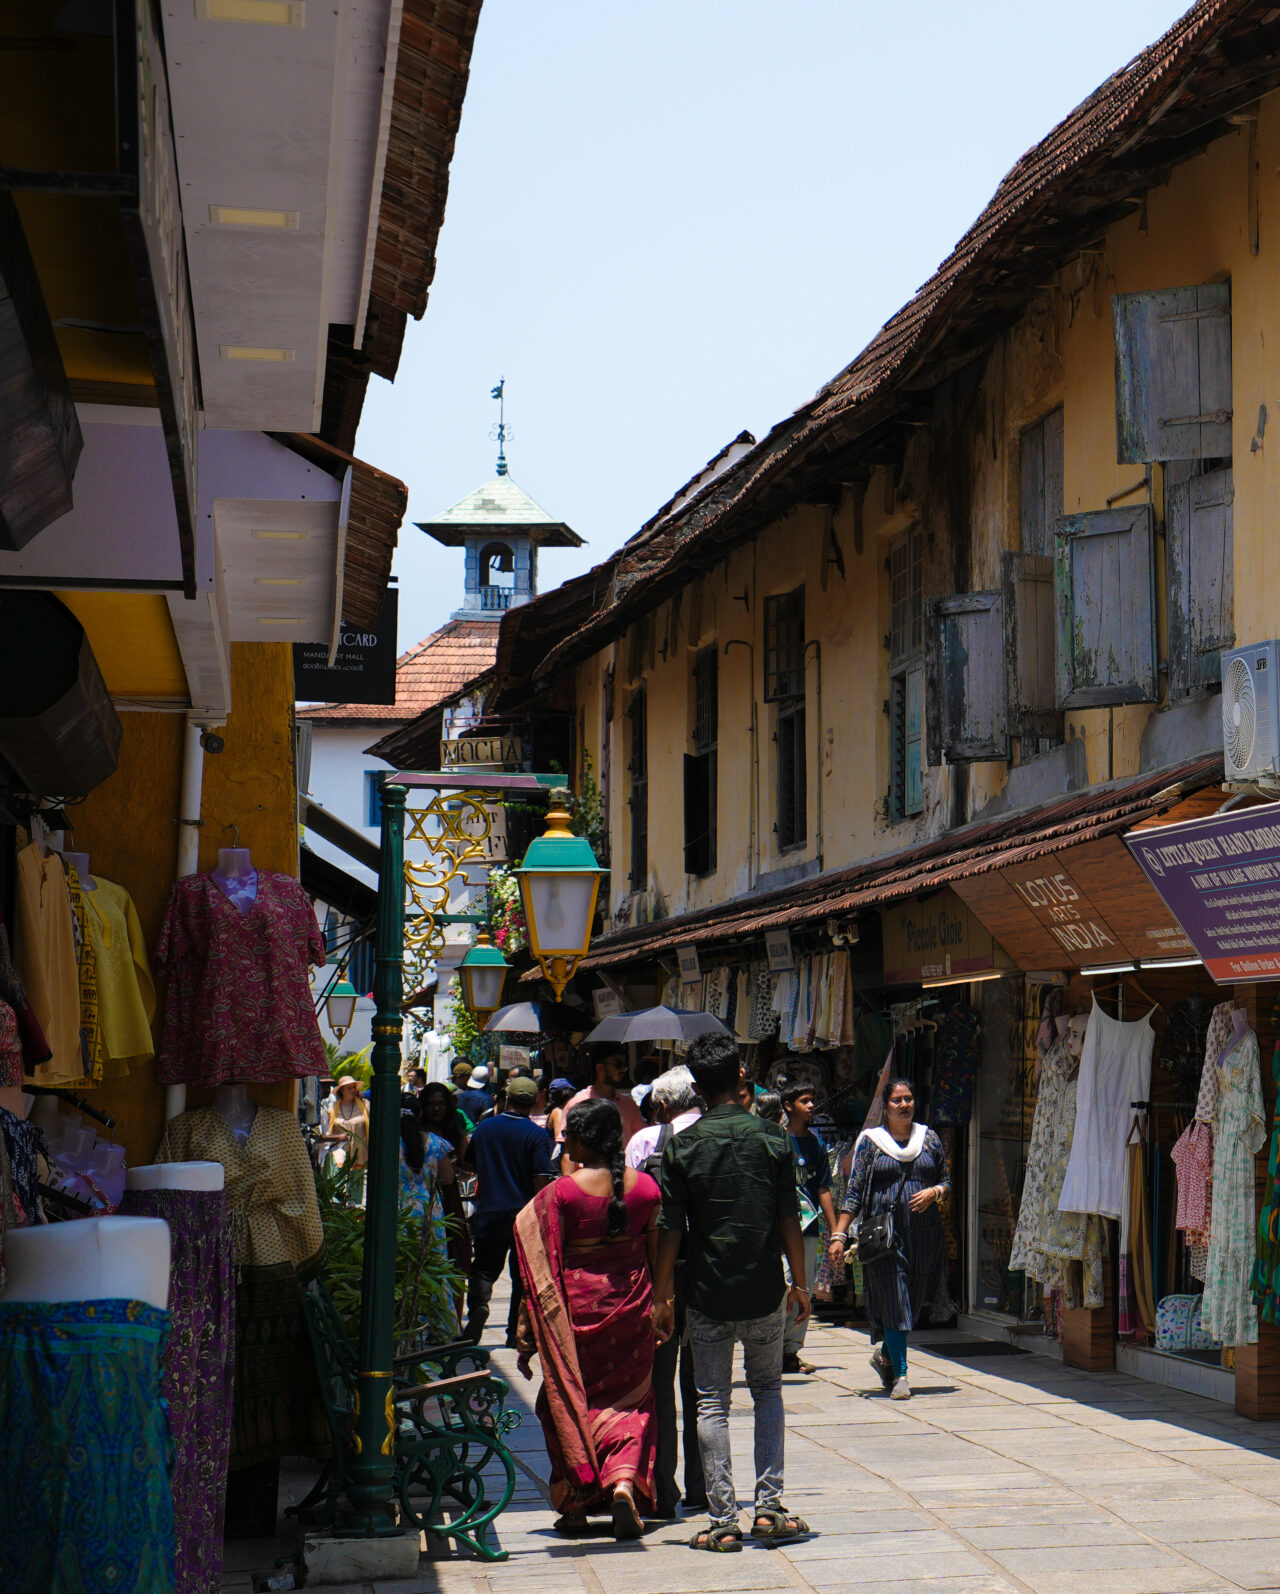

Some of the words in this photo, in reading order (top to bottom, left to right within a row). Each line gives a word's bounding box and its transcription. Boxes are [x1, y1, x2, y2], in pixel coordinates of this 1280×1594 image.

[442, 740, 519, 763] MOCHA
[1156, 843, 1189, 868] LITTLE
[1185, 837, 1223, 866] QUEEN
[1217, 831, 1252, 857] HAND
[1196, 873, 1214, 889] UNIT
[1218, 867, 1250, 885] VILLAGE
[1244, 862, 1278, 881] WOMEN'S
[1016, 874, 1079, 907] LOTUS
[1048, 904, 1080, 922] ARTS
[1051, 921, 1115, 952] INDIA
[1229, 962, 1242, 972] For
[1240, 958, 1261, 971] Online
